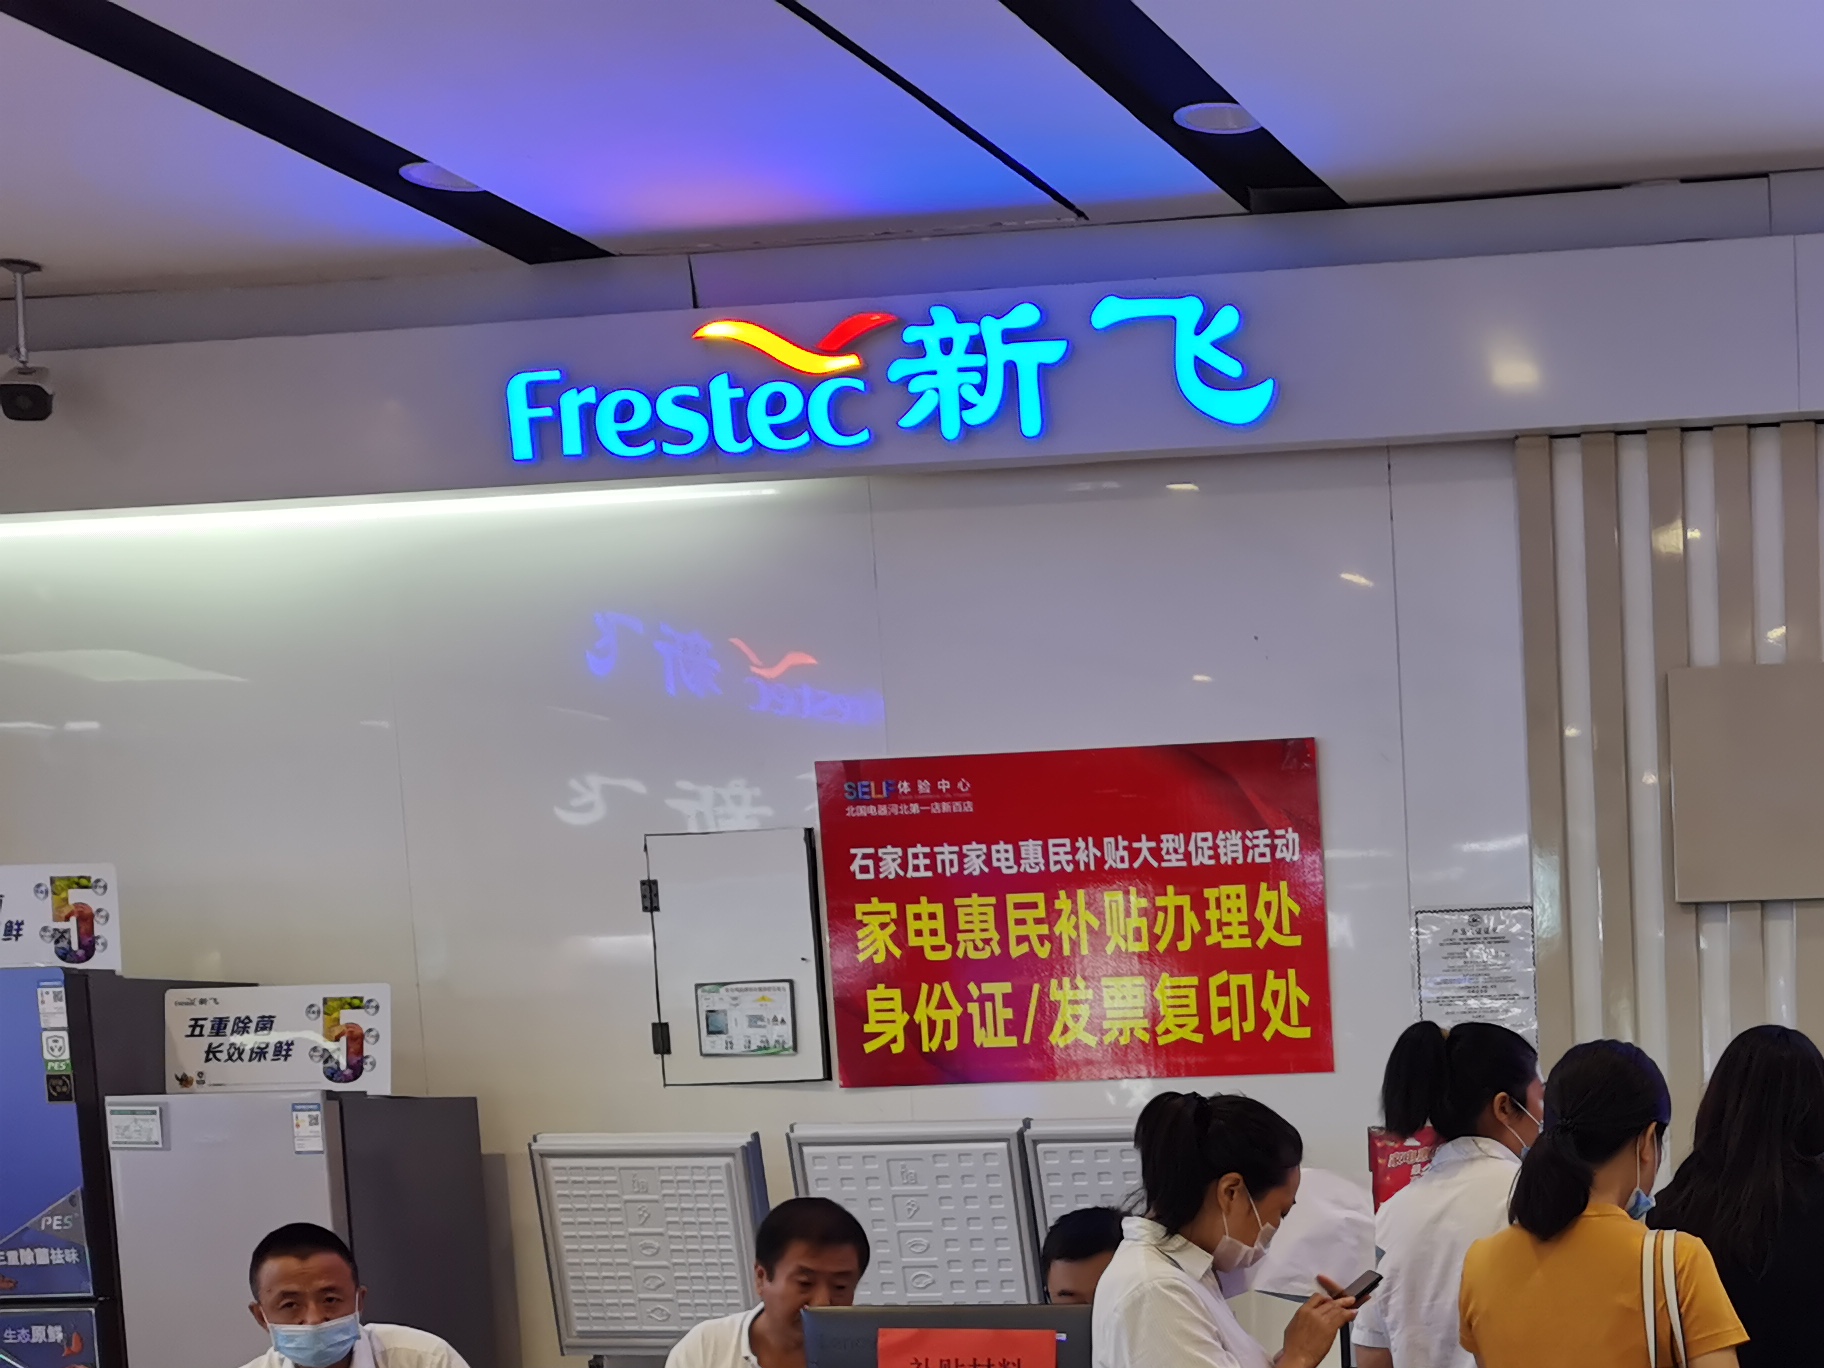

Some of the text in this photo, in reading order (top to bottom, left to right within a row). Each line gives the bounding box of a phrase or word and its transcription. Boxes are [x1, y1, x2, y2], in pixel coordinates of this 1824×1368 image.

[505, 294, 1275, 462] Frestec 新飞
[843, 778, 971, 800] SELF 体验中心
[849, 827, 1301, 881] 石家庄市家电惠民补贴大型促销活动
[854, 880, 1303, 964] 家电惠民补贴办理处
[862, 968, 1312, 1055] 身份证/发票复印处
[184, 1015, 276, 1038] 五重除菌
[204, 1040, 295, 1063] 长效保鲜
[41, 1215, 73, 1230] PES
[3, 1325, 64, 1344] 生态原鲜
